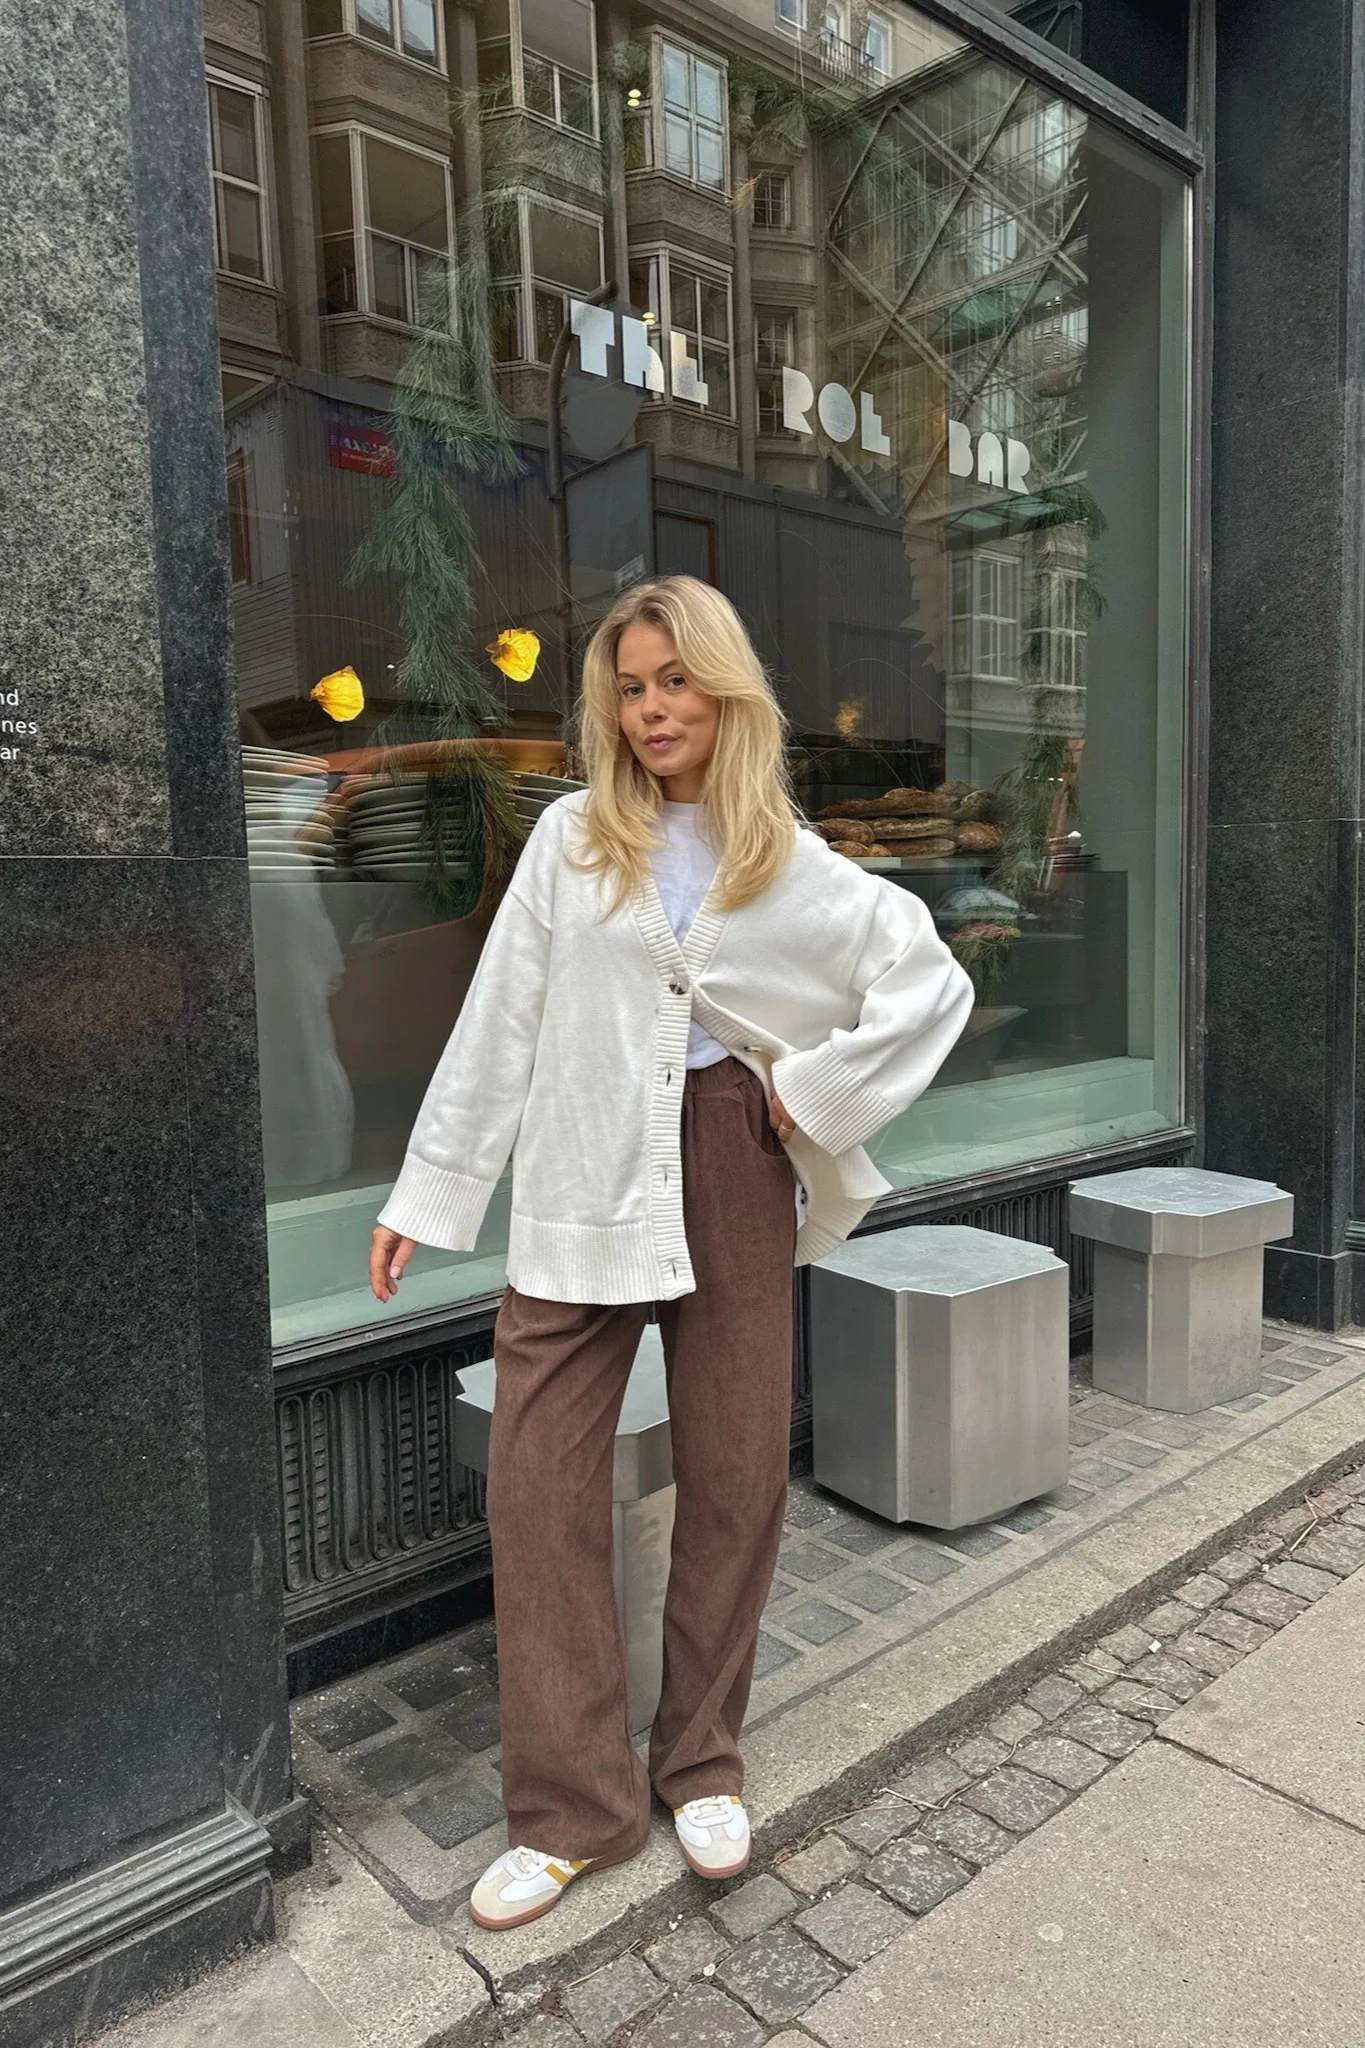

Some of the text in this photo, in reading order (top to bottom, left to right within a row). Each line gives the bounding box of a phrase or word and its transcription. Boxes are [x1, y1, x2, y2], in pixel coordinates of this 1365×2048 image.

[948, 418, 1032, 495] BAR
[1, 719, 38, 735] nes
[0, 746, 21, 760] ar
